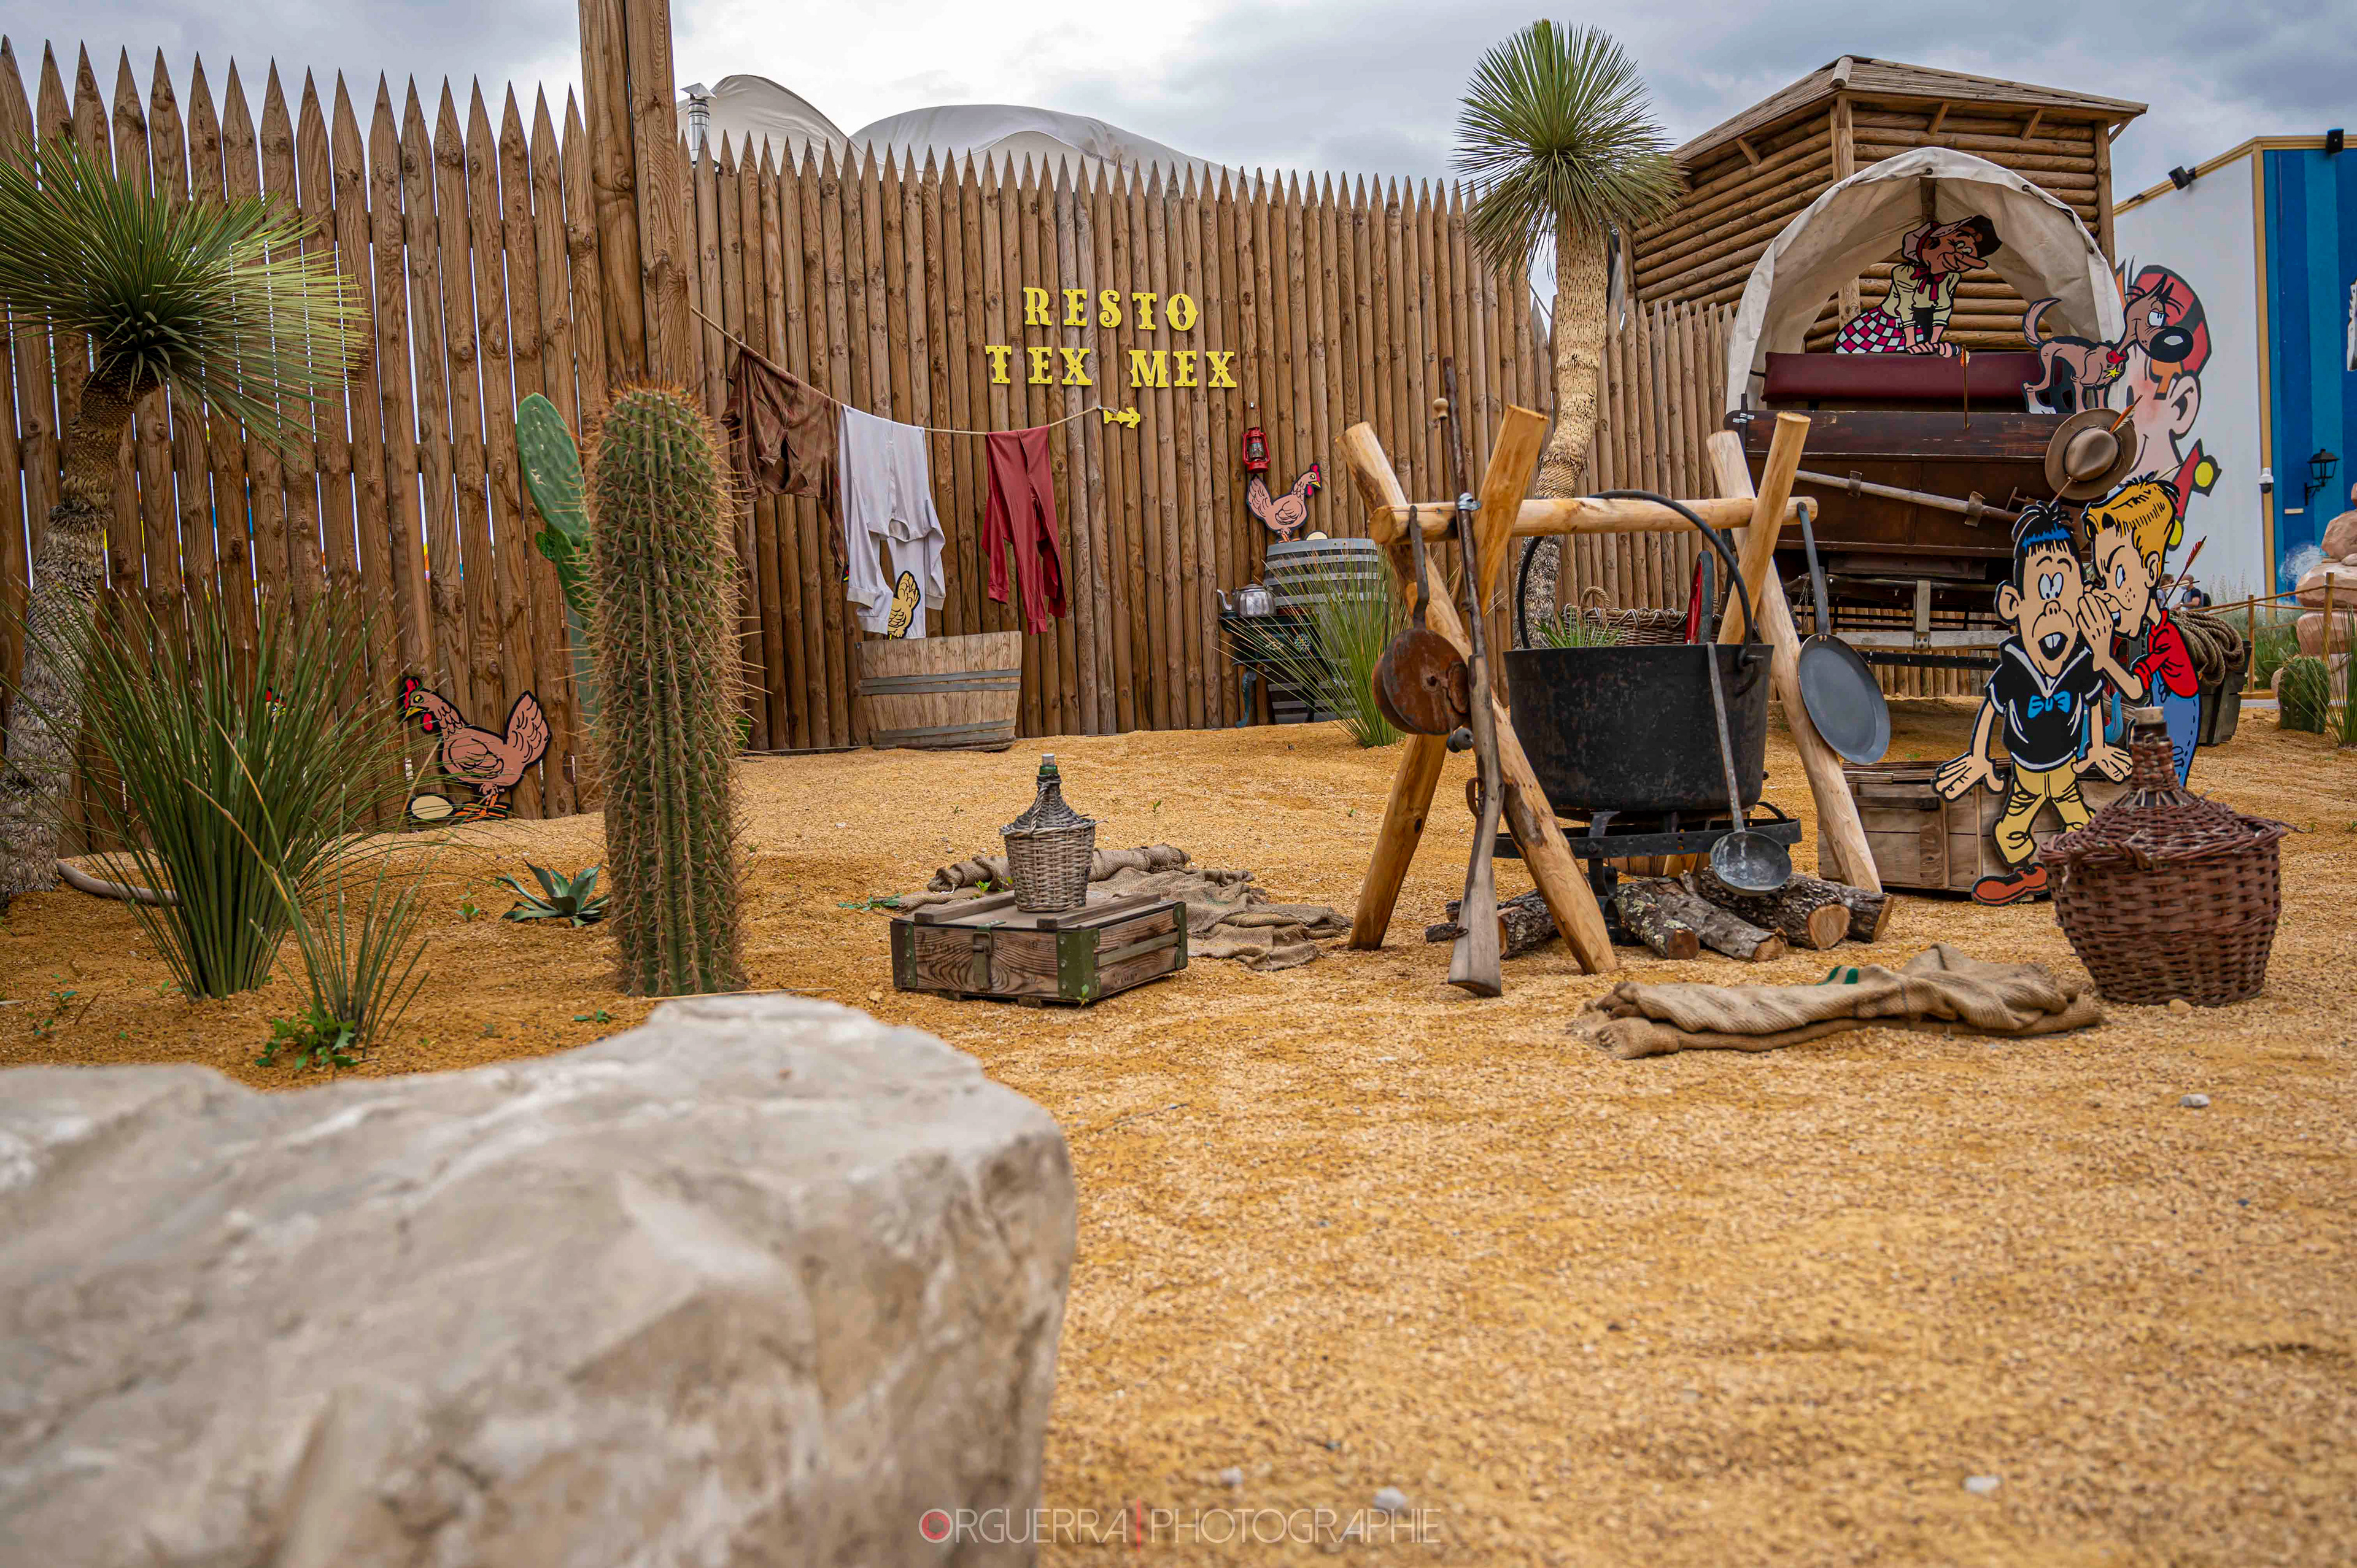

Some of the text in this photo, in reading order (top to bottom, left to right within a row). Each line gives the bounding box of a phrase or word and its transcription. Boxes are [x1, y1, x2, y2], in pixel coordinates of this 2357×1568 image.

[1023, 287, 1200, 331] RESTO
[985, 344, 1237, 388] TEX MEX
